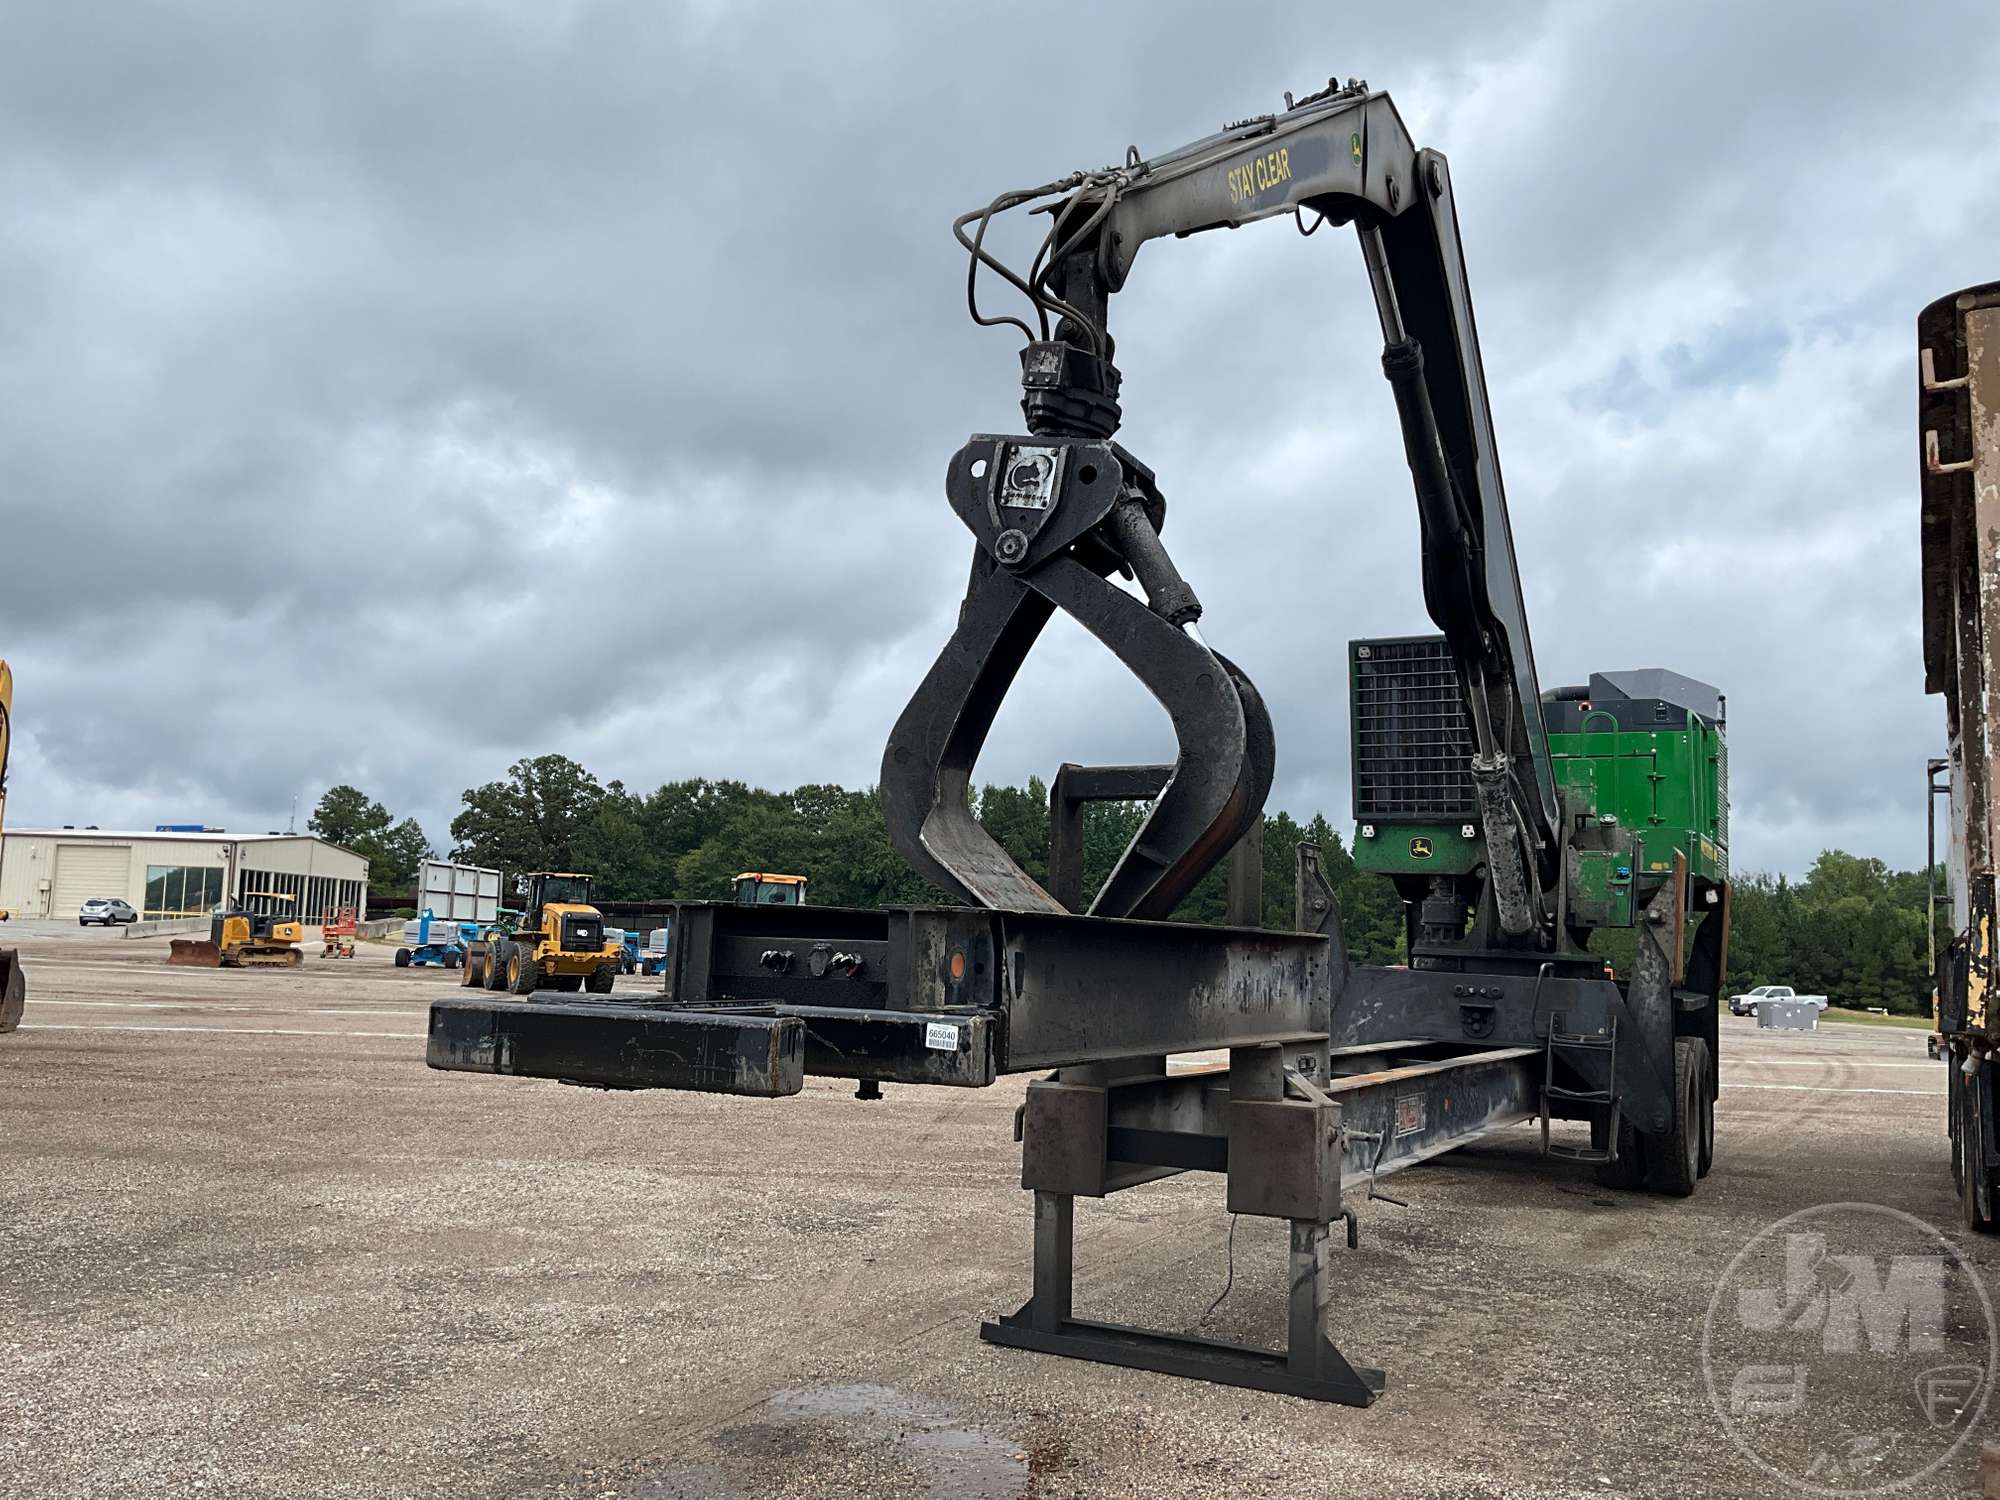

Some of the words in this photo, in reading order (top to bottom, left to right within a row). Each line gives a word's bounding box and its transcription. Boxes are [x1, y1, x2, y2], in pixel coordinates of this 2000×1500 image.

[1228, 161, 1256, 204] STAY
[1256, 148, 1292, 191] CLEAR
[928, 1028, 956, 1041] 665040
